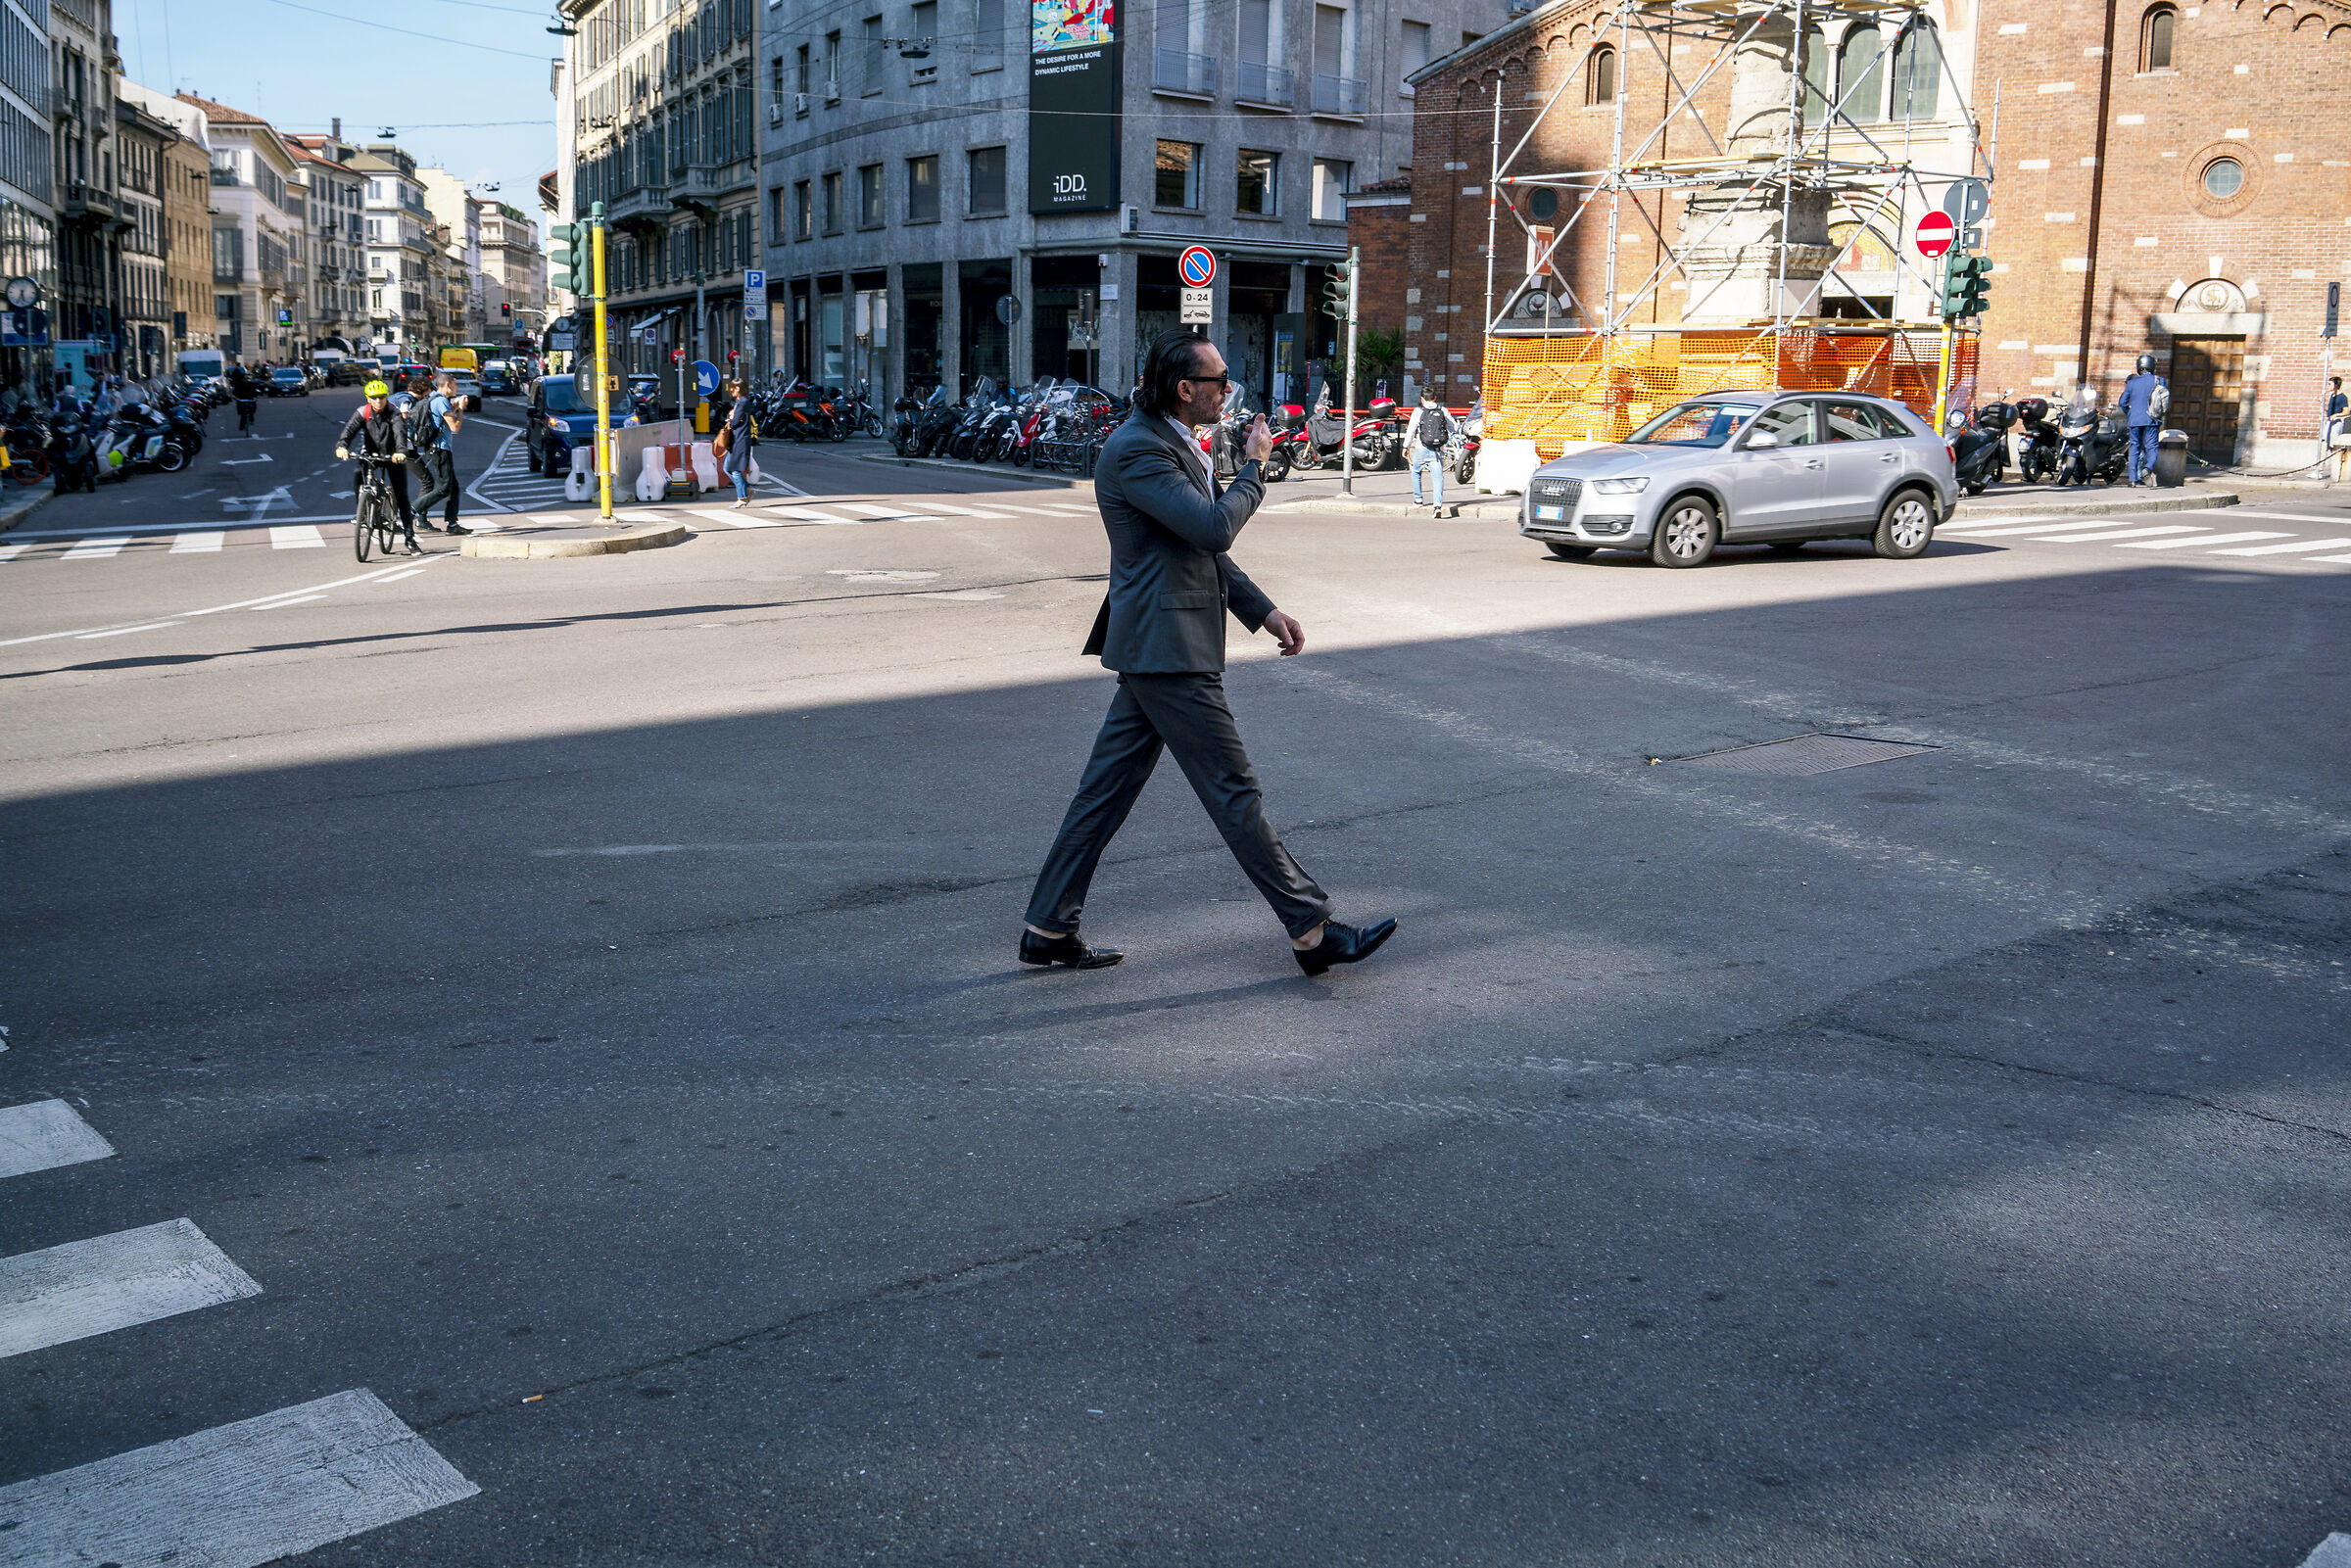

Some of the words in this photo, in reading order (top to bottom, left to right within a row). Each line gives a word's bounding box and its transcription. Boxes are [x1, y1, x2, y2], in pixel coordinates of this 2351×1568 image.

[1066, 24, 1089, 34] DESIGN
[1061, 64, 1089, 72] LIFESTYLE
[750, 274, 760, 286] P
